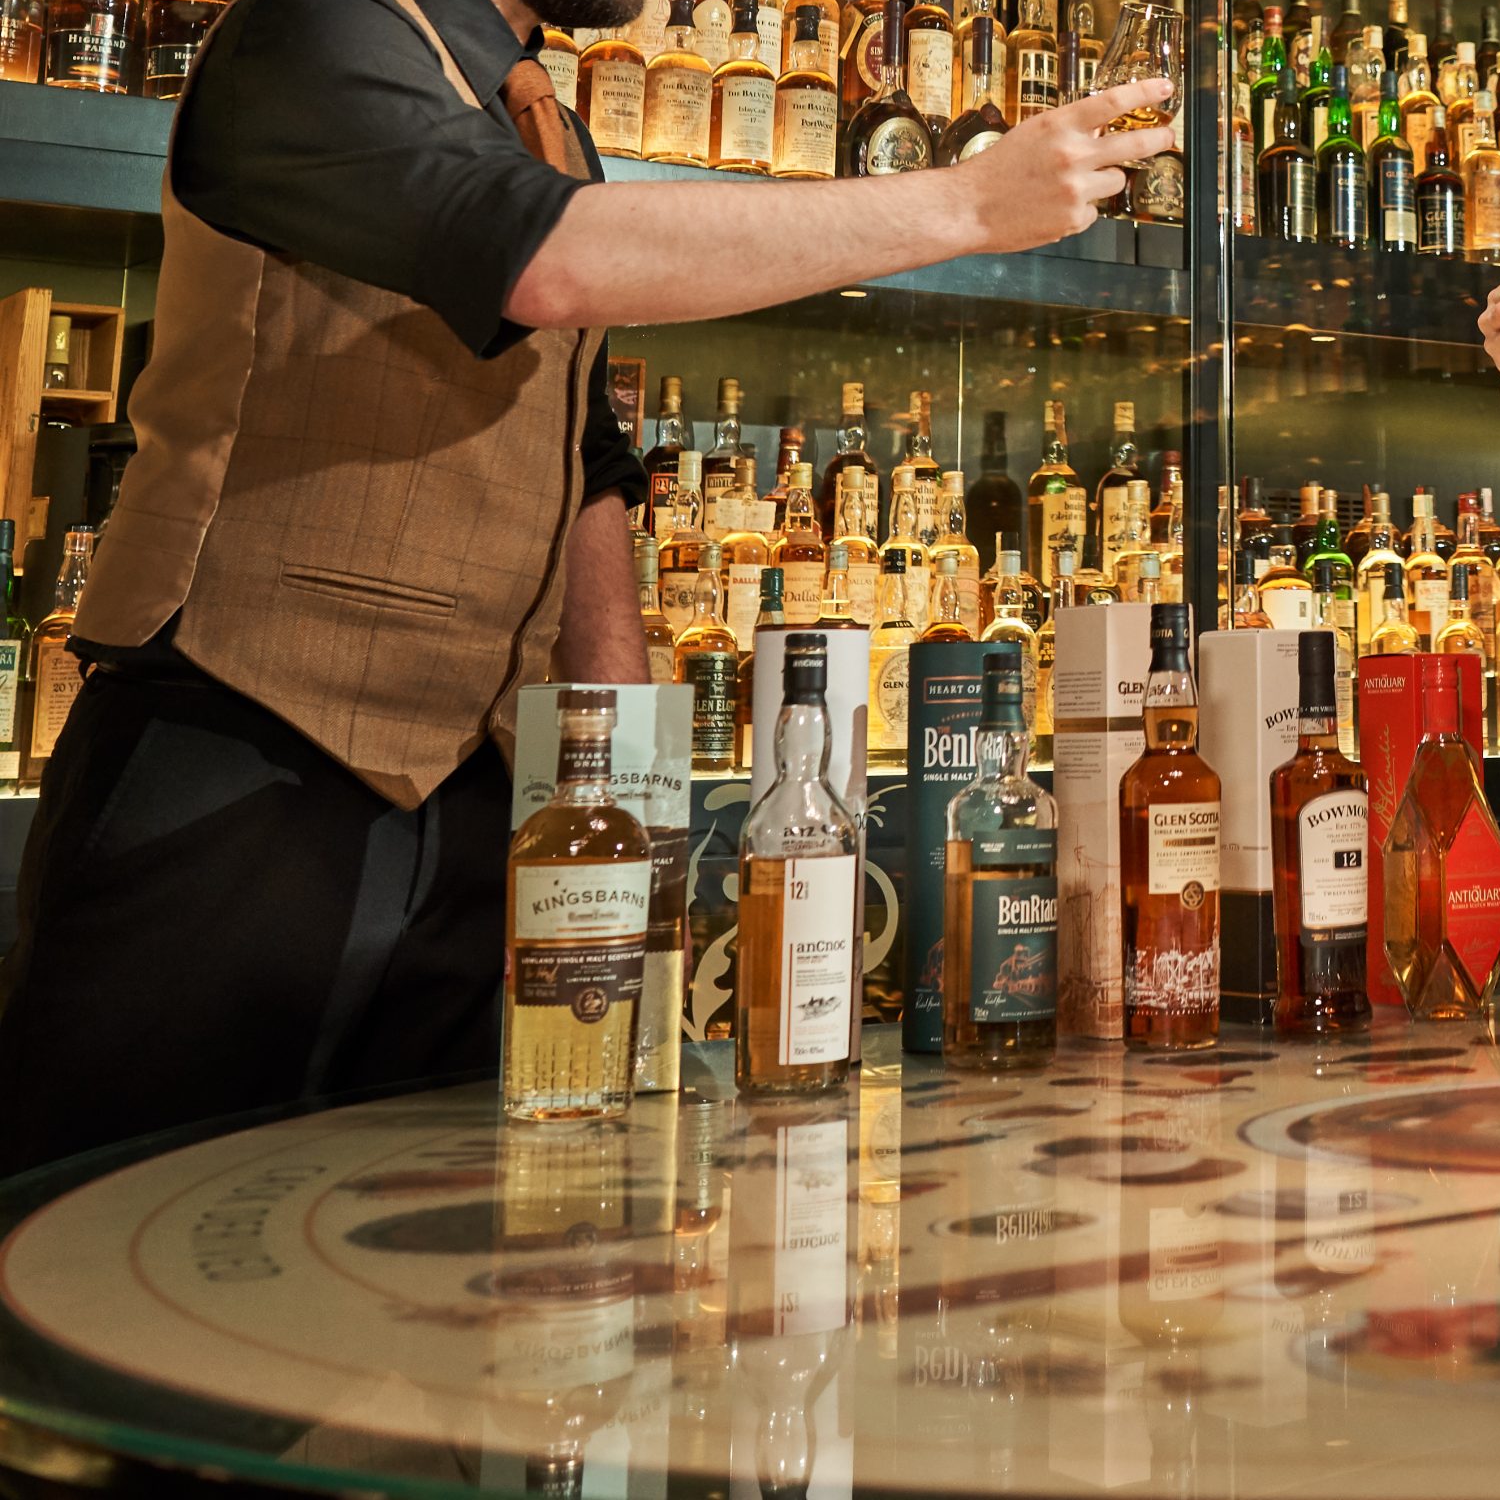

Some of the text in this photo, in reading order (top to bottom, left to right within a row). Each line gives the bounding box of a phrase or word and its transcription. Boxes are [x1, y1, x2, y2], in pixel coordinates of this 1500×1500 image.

[68, 33, 126, 49] HIGHLAND
[792, 103, 805, 111] THE
[783, 590, 820, 604] Dallas
[713, 672, 724, 681] 12
[52, 682, 66, 694] 20
[928, 683, 982, 695] HEART OF
[1364, 677, 1407, 690] ANTIQUARY
[563, 752, 600, 761] DREAM
[573, 760, 606, 768] DRAM
[610, 773, 682, 791] GSBARNS
[923, 772, 973, 783] SINGLE MALT
[1154, 813, 1187, 827] GLEN
[1154, 828, 1172, 836] SINGLE
[1342, 851, 1357, 867] 12
[790, 881, 803, 900] 12
[532, 890, 645, 916] KINGSBARNS
[998, 927, 1018, 935] SINGLE
[1019, 926, 1033, 934] MALT
[796, 940, 846, 954] anCnoc
[521, 956, 554, 965] LOWLAND
[556, 955, 584, 964] SINGLE
[586, 954, 606, 963] MALT
